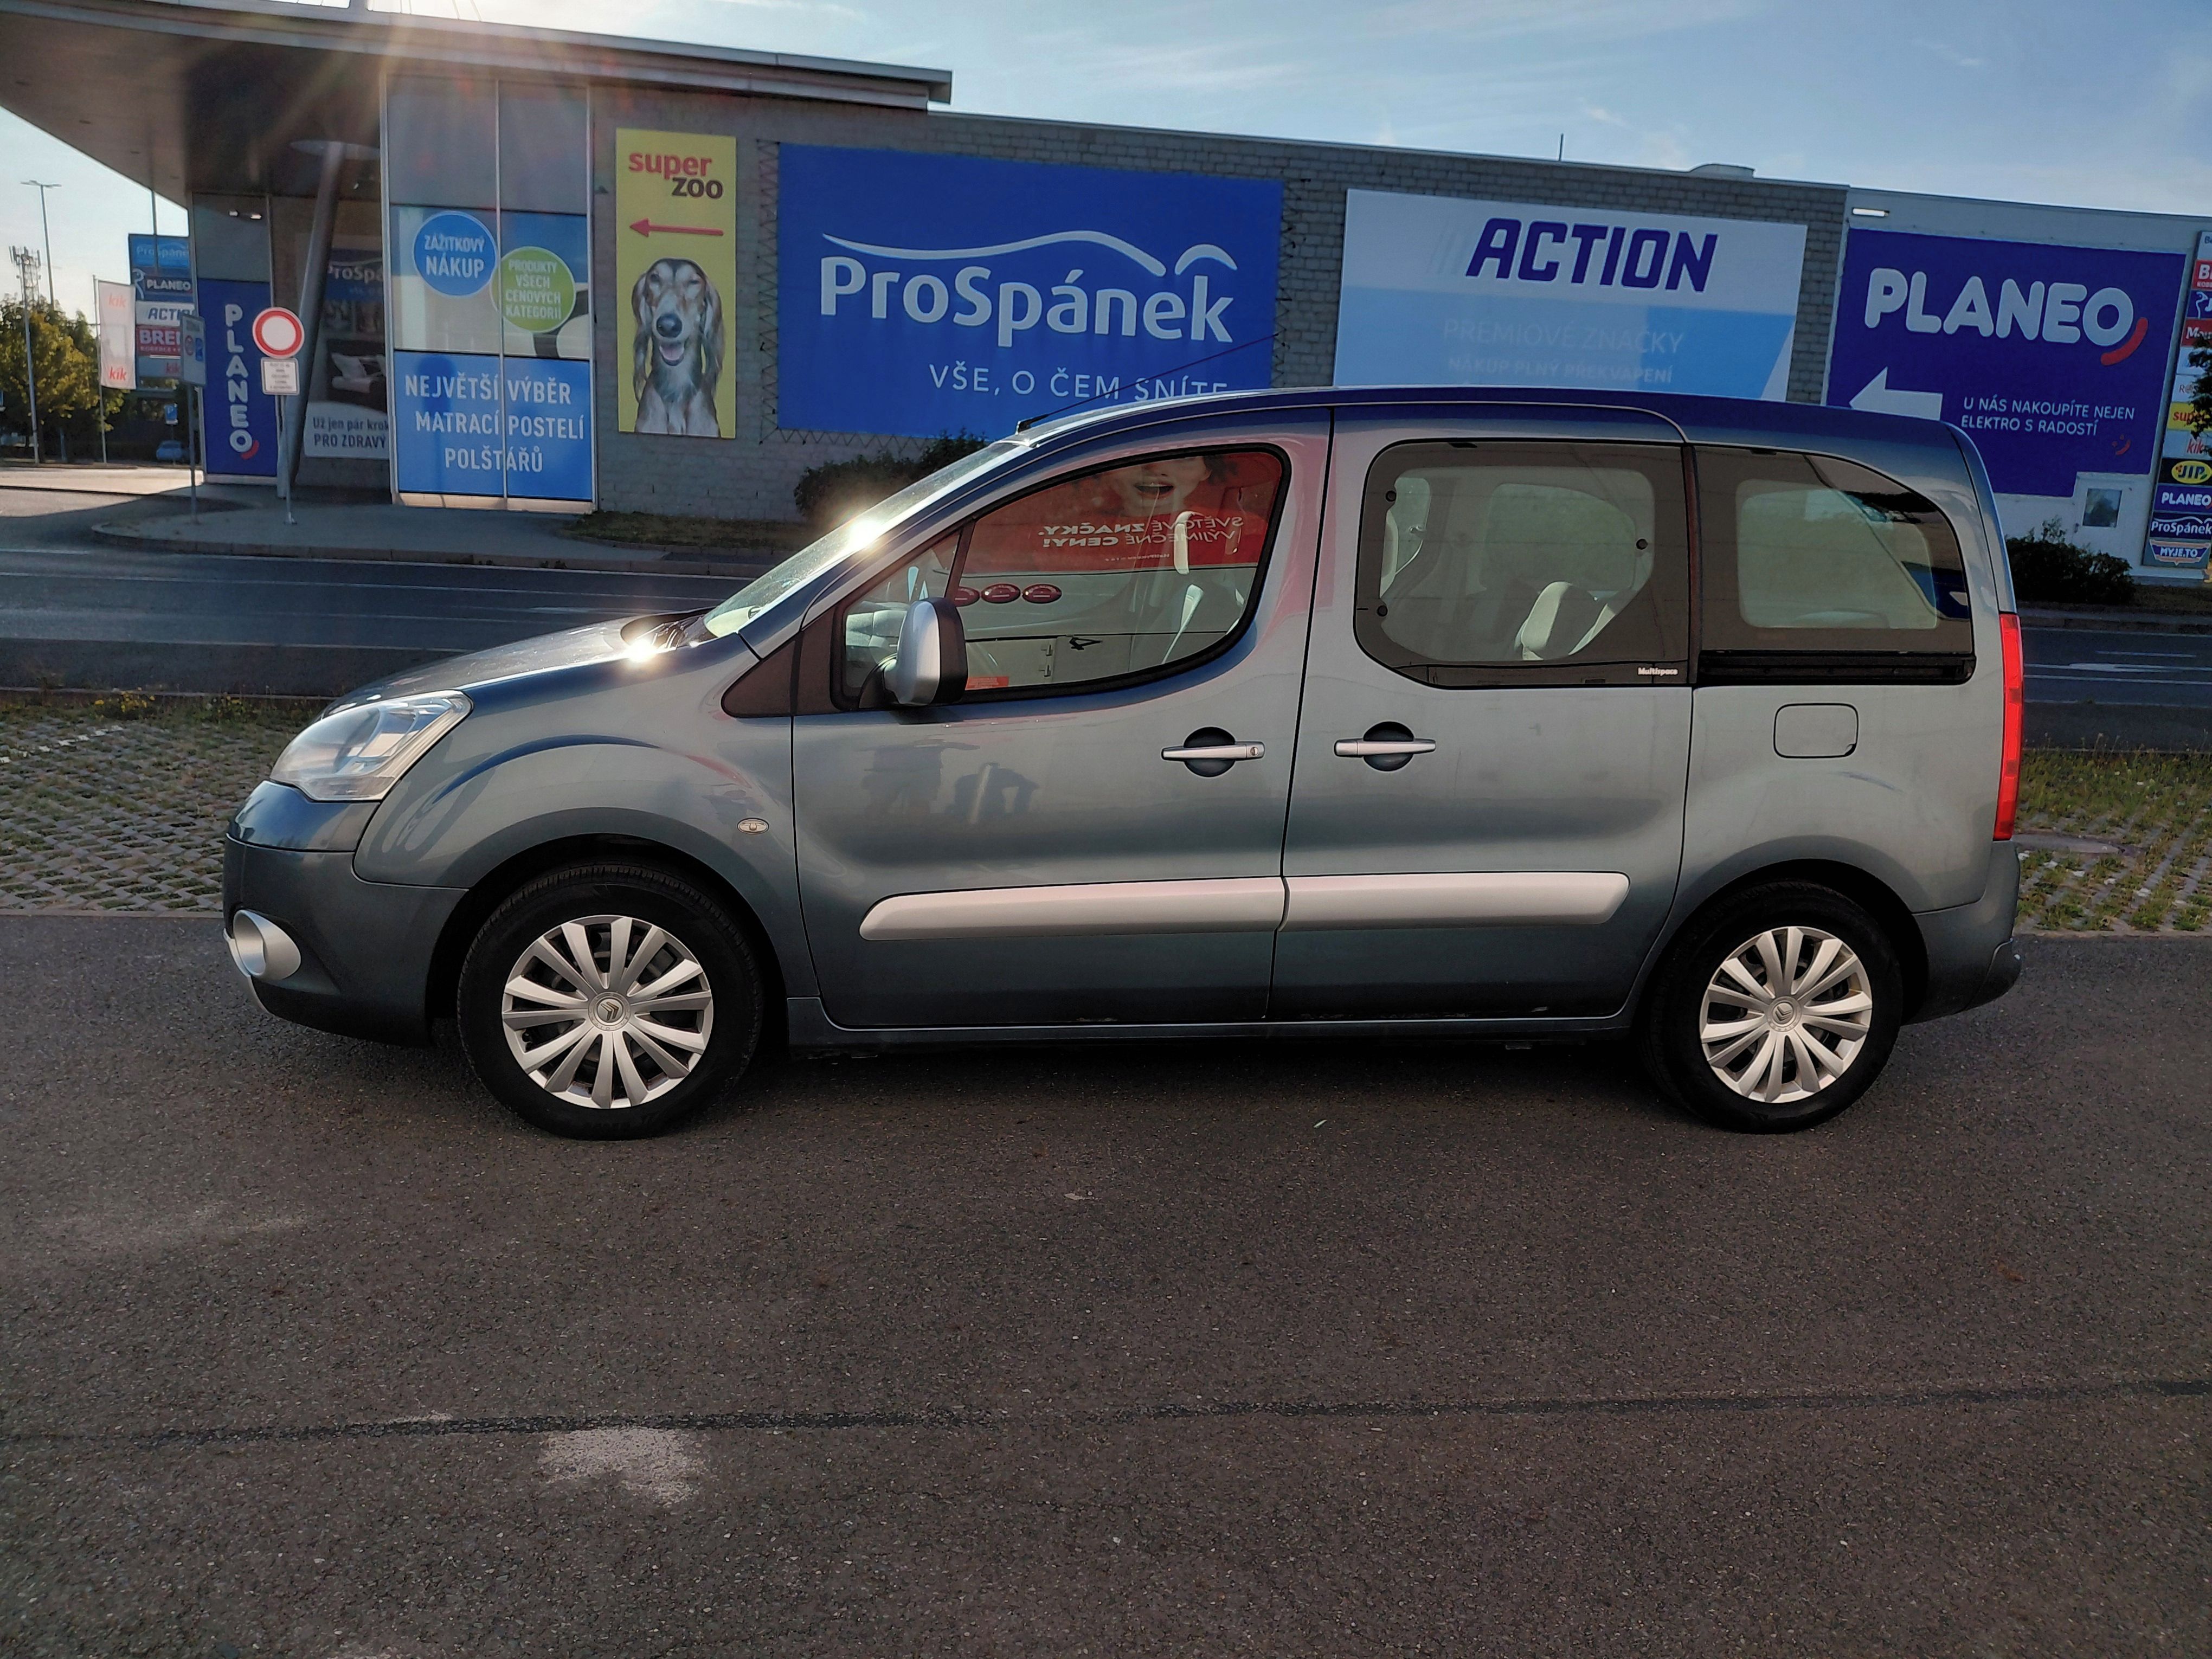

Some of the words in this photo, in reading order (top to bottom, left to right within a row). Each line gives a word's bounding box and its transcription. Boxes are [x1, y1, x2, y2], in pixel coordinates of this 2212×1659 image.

[628, 152, 712, 180] super
[672, 177, 723, 199] zoo
[424, 233, 485, 253] ZÁŽITKOVÝ
[1465, 217, 1719, 292] ACTION
[426, 253, 484, 279] NÁKUP
[508, 259, 558, 274] PRODUKTY
[146, 279, 191, 291] PLANEO
[515, 271, 550, 289] VŠECH
[109, 294, 126, 308] kik
[505, 288, 561, 304] CENOVÝCH
[820, 256, 1234, 348] ProSpánek
[1864, 267, 2134, 347] PLANEO
[110, 366, 127, 381] kik
[224, 304, 253, 453] PLANEO
[929, 360, 1000, 396] VŠE,
[1012, 369, 1036, 395] O
[1050, 366, 1120, 401] ČEM
[405, 371, 499, 401] NEJVĚTŠÍ
[507, 375, 571, 406] VÝBĚR
[1963, 396, 1974, 410] U
[1978, 394, 2007, 412] NÁS
[2011, 399, 2089, 419] NAKOUPÍTE
[2093, 405, 2135, 420] NEJEN
[415, 409, 499, 435] MATRACÍ
[508, 414, 584, 440] POSTELÍ
[1960, 414, 2021, 431] ELEKTRO
[2024, 419, 2034, 433] S
[2037, 419, 2099, 436] RADOSTÍ
[314, 433, 338, 448] PRO
[445, 444, 543, 473] POLŠTÁŘŮ
[2178, 465, 2205, 479] JIP
[2161, 492, 2212, 506] PLANEO
[2151, 520, 2212, 536] ProSpánek
